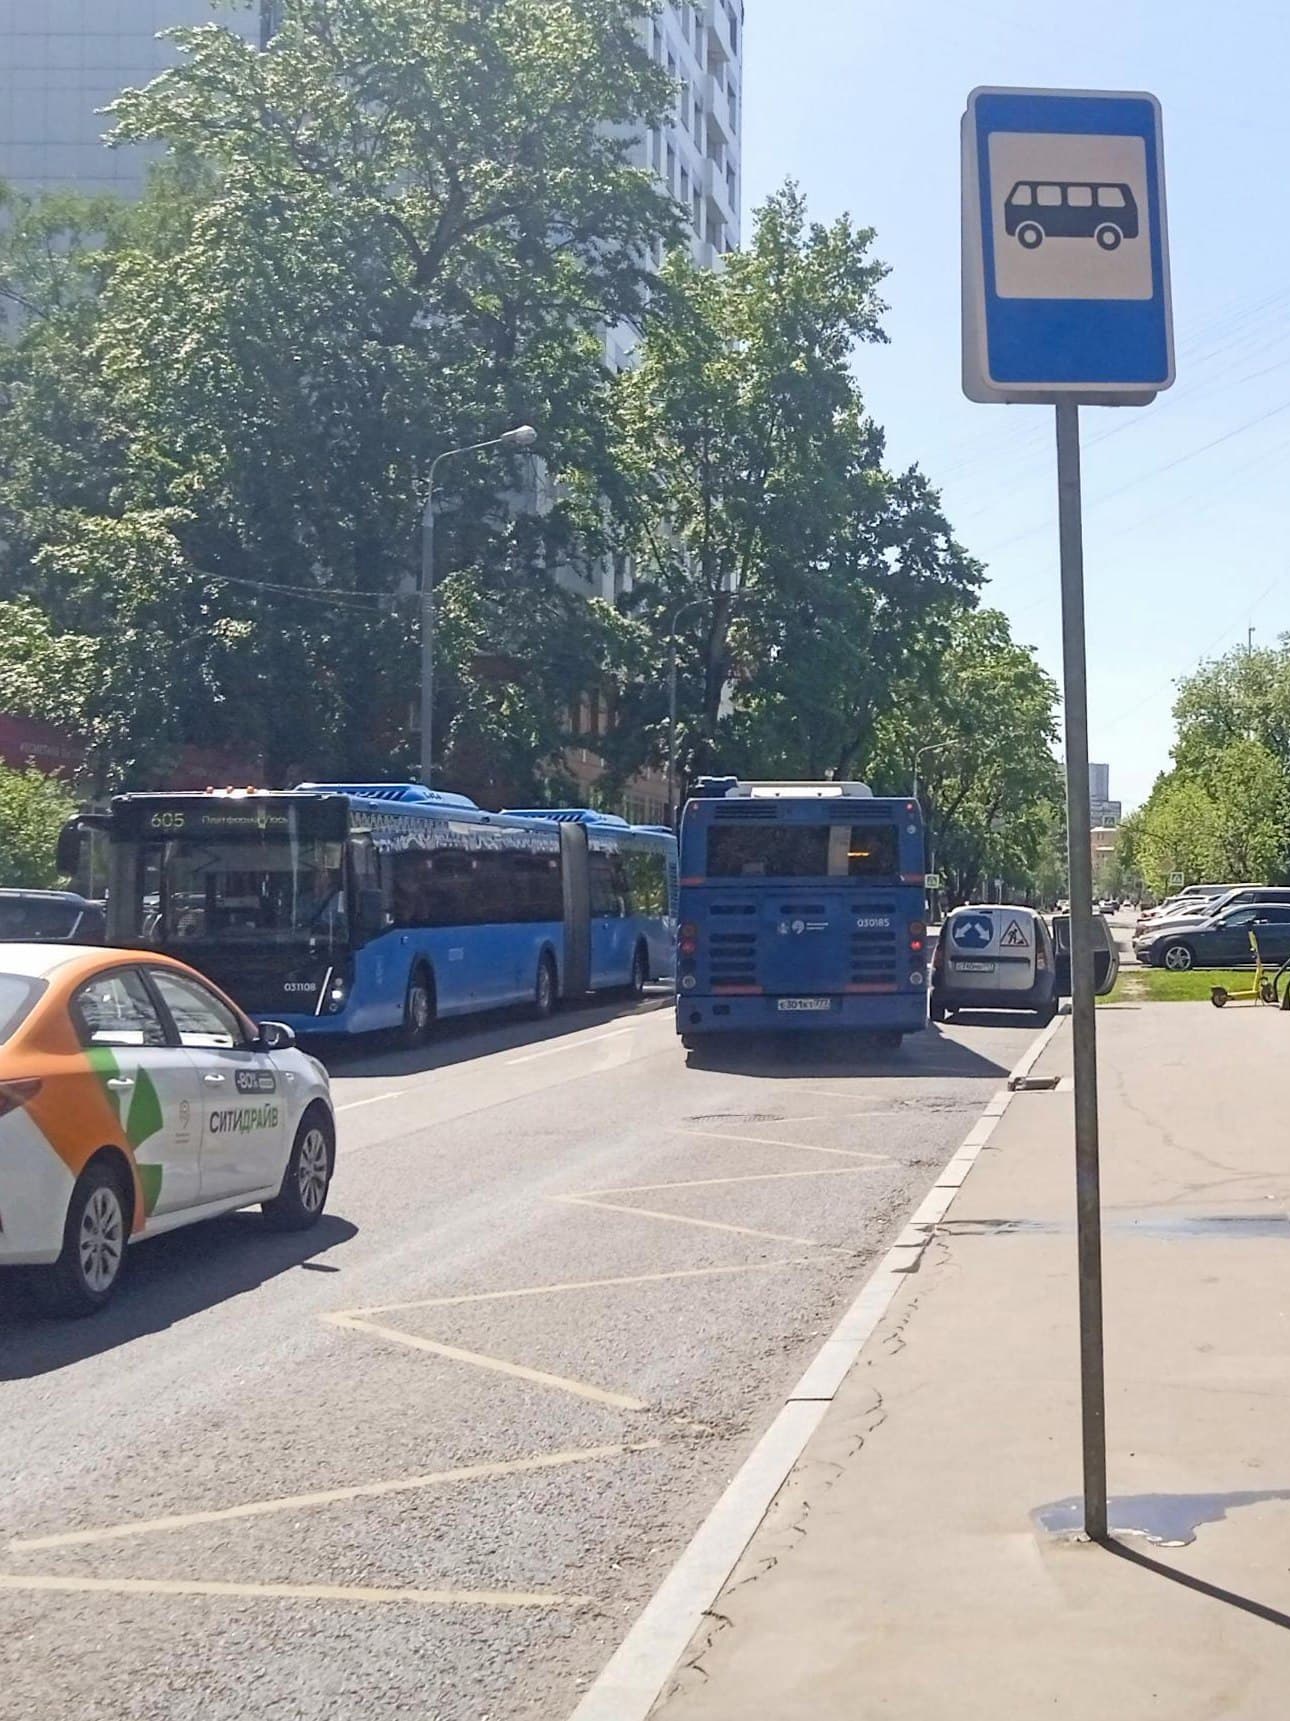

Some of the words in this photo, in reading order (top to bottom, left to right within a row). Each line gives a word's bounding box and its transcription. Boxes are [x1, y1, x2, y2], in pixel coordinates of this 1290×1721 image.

[151, 812, 185, 828] 605
[857, 918, 890, 928] 030185
[283, 983, 317, 992] 031108
[209, 1103, 279, 1135] СИТИДРАЙВ
